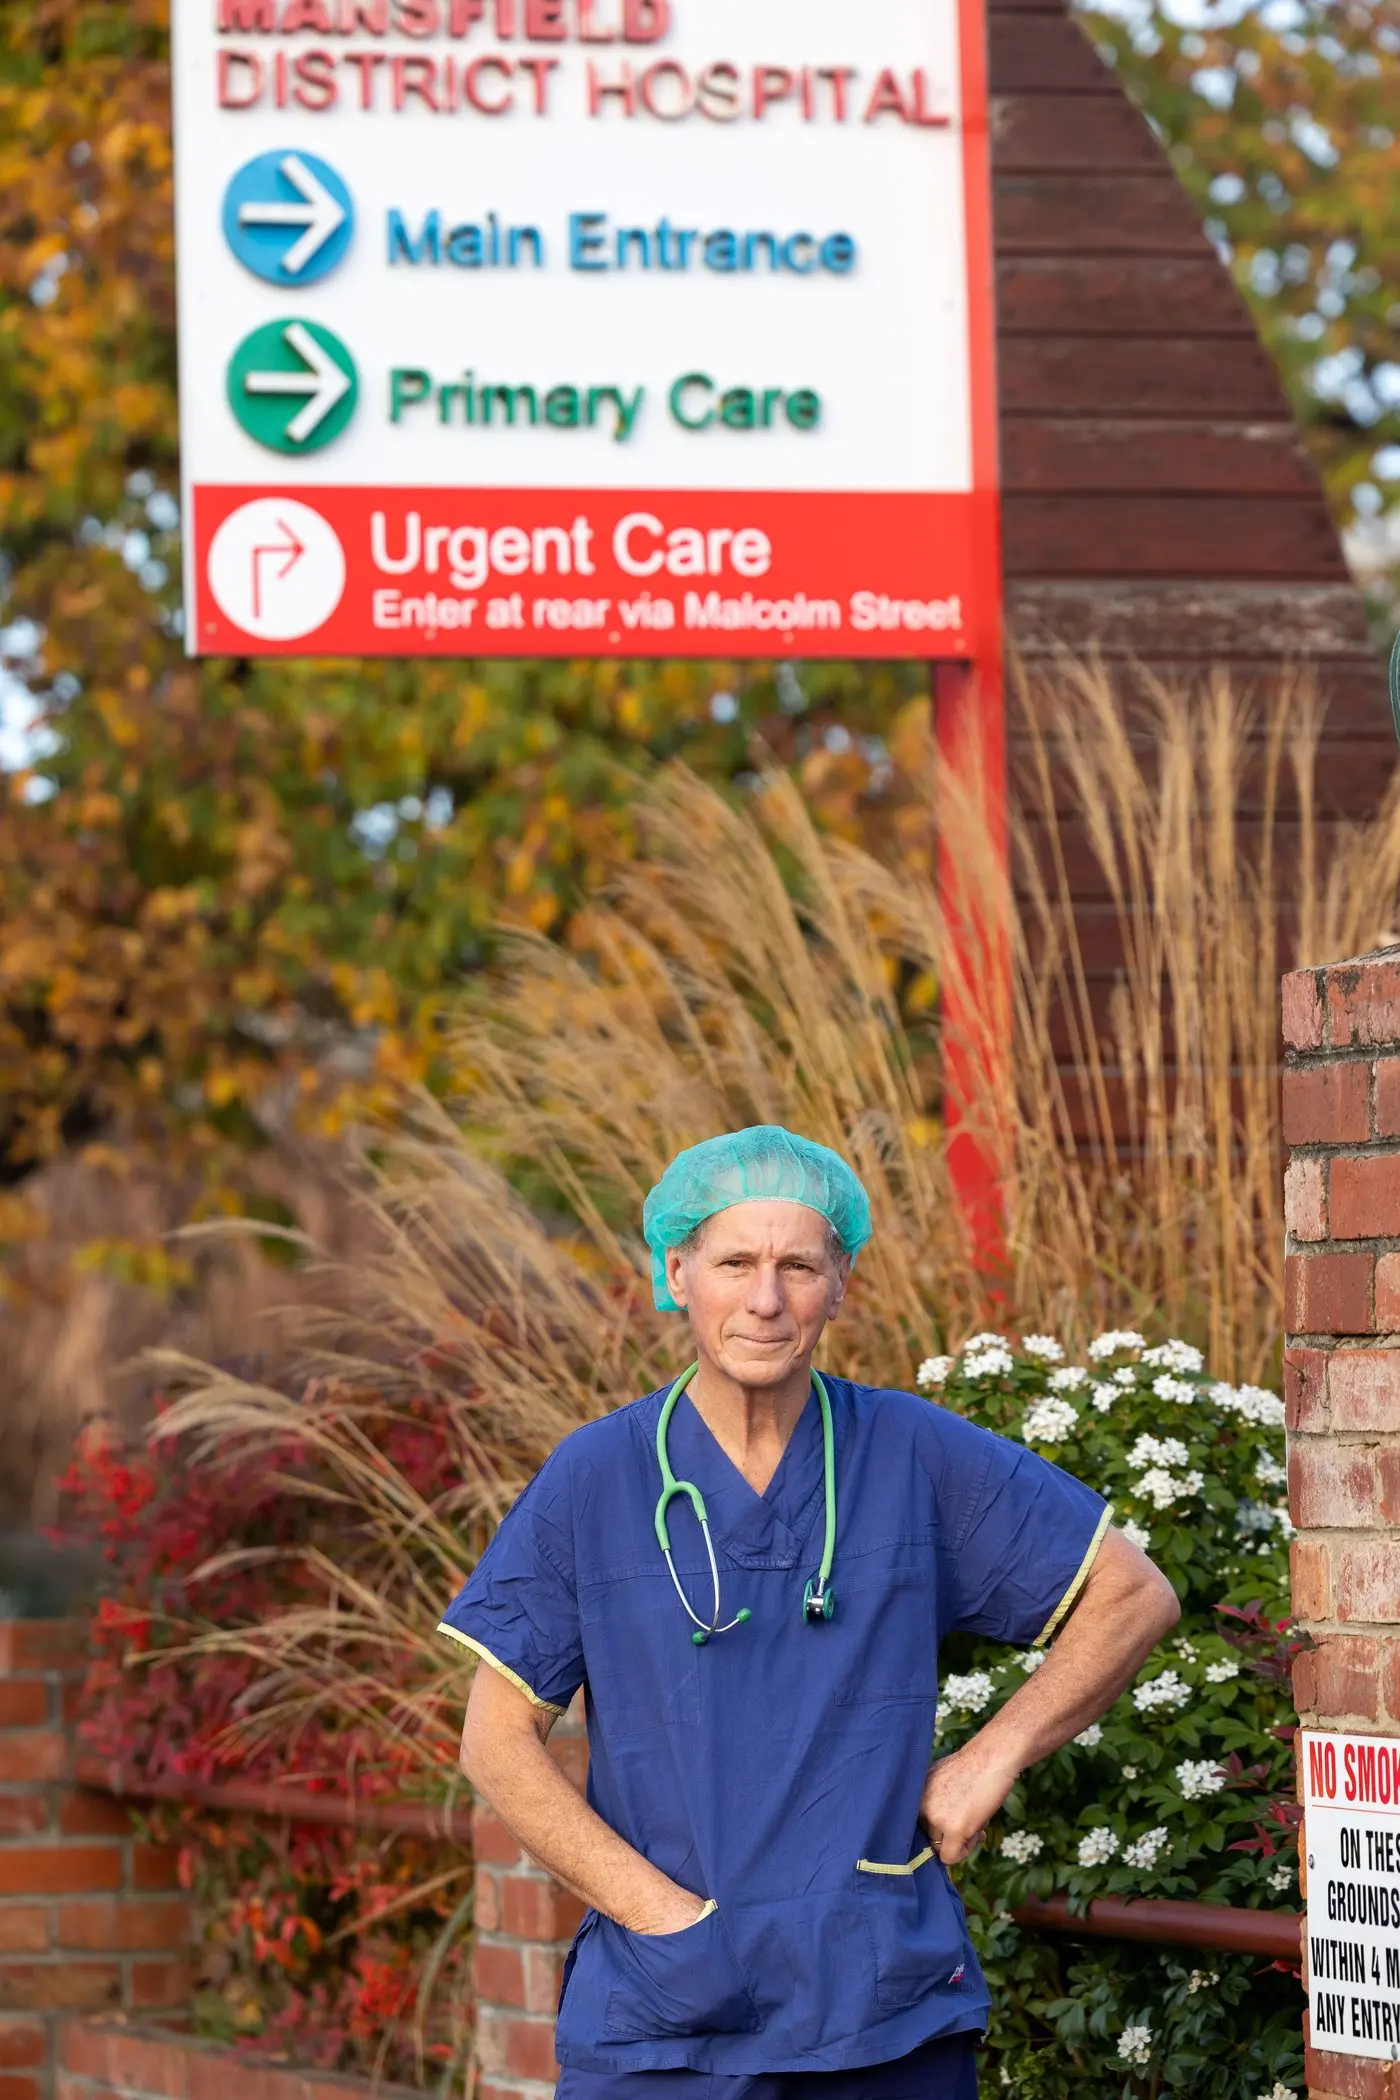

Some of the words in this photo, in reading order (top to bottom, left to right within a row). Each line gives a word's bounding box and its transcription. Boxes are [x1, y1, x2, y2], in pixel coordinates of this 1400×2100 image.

[216, 0, 670, 45] MANSFIELD
[217, 49, 558, 117] DISTRICT
[586, 60, 951, 127] HOSPITAL
[386, 208, 544, 270] Main
[568, 212, 857, 276] Entrance
[389, 368, 644, 442] Primary
[669, 373, 822, 432] Care
[371, 511, 595, 589] Urgent
[613, 513, 772, 576] Care
[373, 590, 476, 628] Enter
[485, 594, 525, 628] at
[534, 597, 608, 629] rear
[619, 594, 675, 629] via
[684, 593, 841, 630] Malcolm
[850, 593, 963, 631] Street
[1309, 1741, 1337, 1800] NO
[1340, 1827, 1361, 1869] ON
[1327, 1880, 1400, 1929] GROUNDS
[1310, 1936, 1366, 1984] WITHIN
[1371, 1946, 1381, 1986] 4
[1316, 1991, 1346, 2035] ANY
